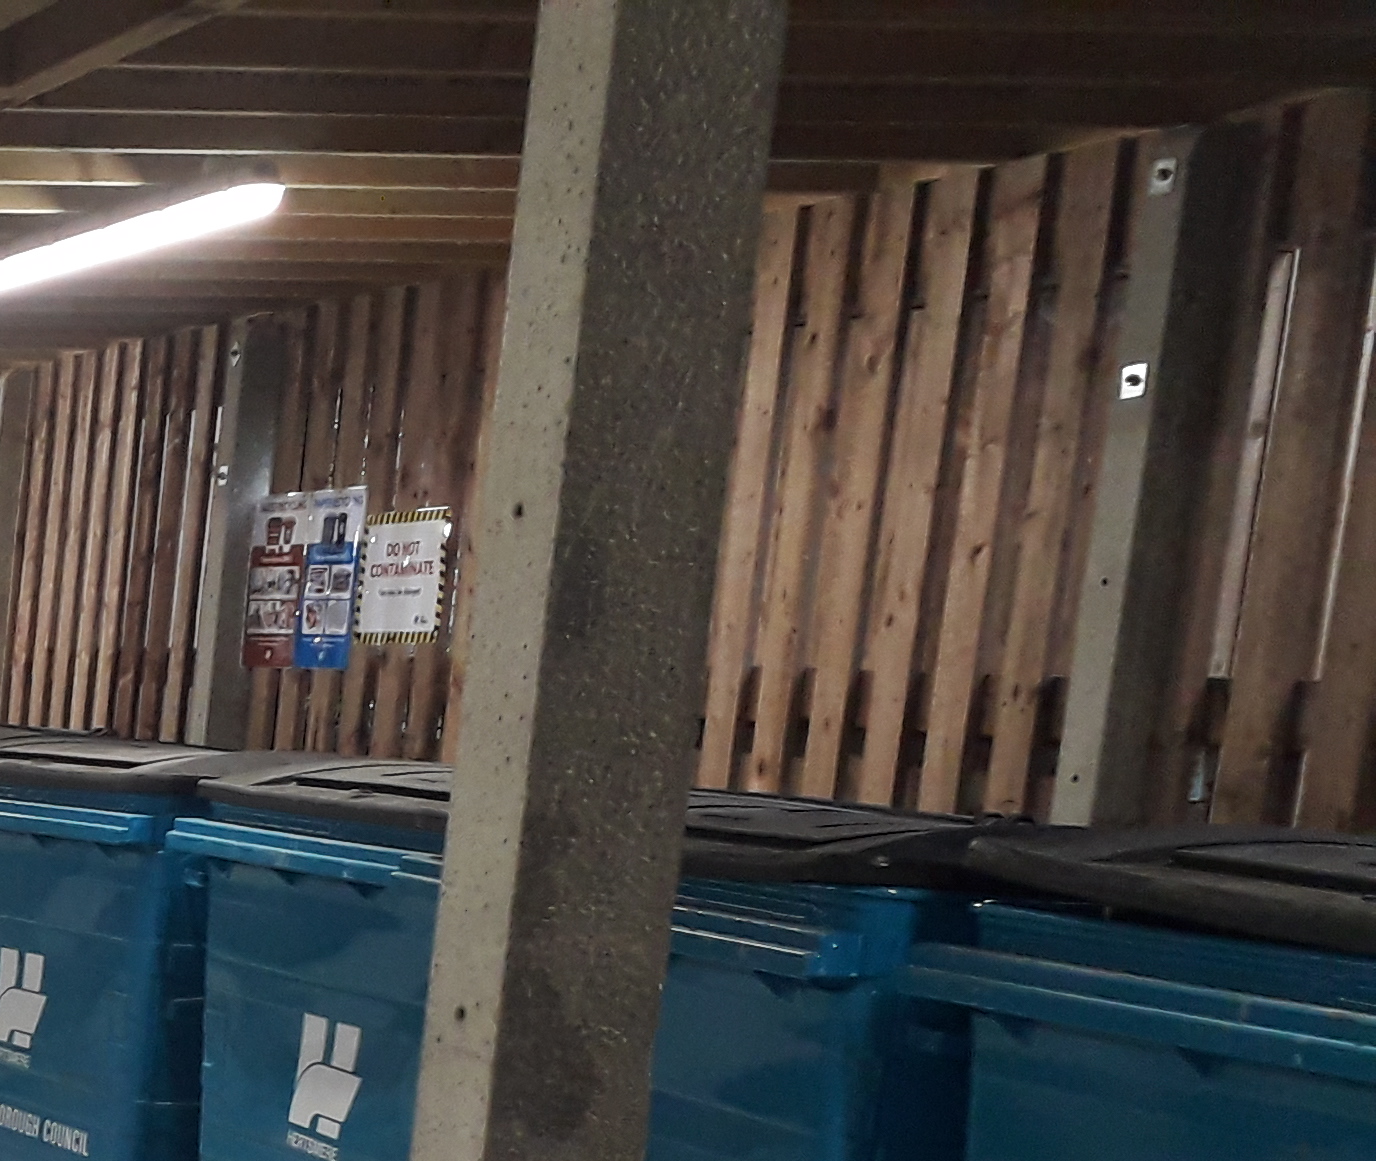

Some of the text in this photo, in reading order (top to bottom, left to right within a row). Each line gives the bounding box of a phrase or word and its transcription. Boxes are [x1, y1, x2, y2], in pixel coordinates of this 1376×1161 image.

[386, 541, 421, 557] DO NOT
[43, 1119, 89, 1157] COUNCIL
